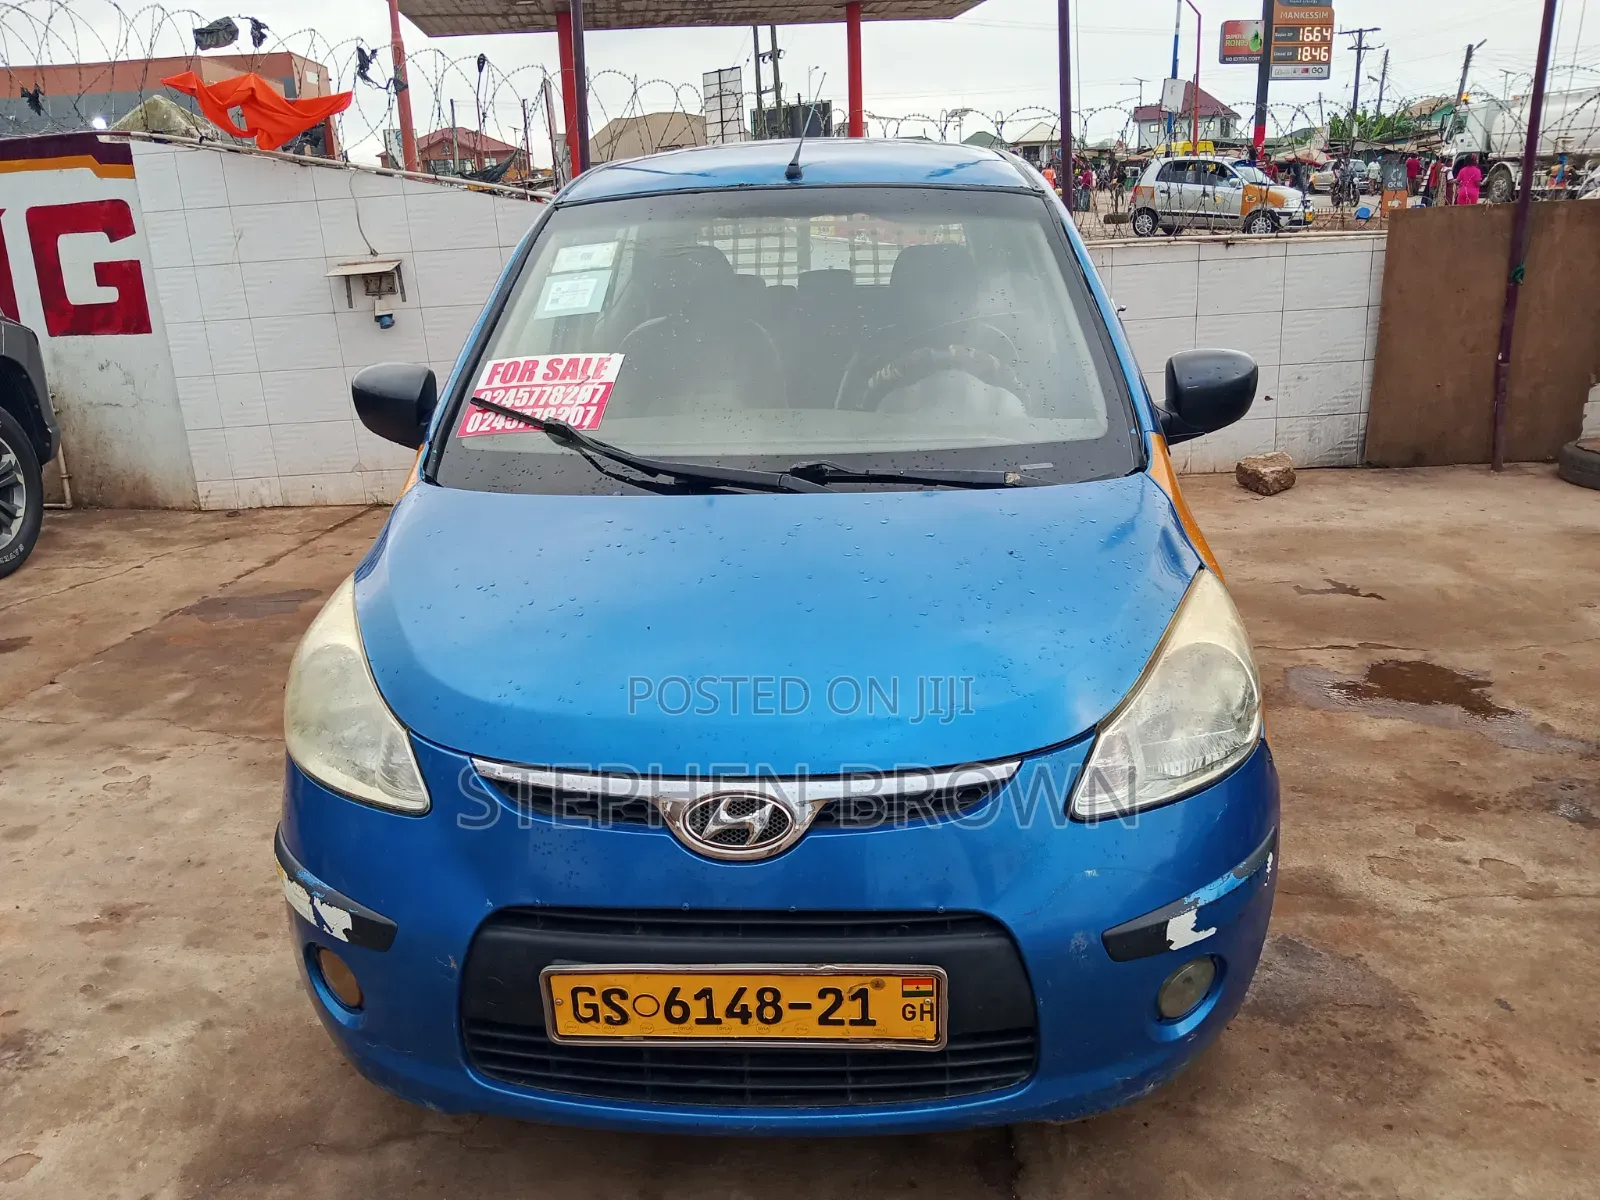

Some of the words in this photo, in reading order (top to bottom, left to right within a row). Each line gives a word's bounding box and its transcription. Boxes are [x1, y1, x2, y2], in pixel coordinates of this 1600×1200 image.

[1280, 11, 1329, 19] MANKESSIM
[486, 359, 539, 386] FOR
[542, 357, 612, 382] SALE
[570, 986, 631, 1027] GS
[663, 986, 878, 1028] 6148-21
[901, 1002, 936, 1023] GH
